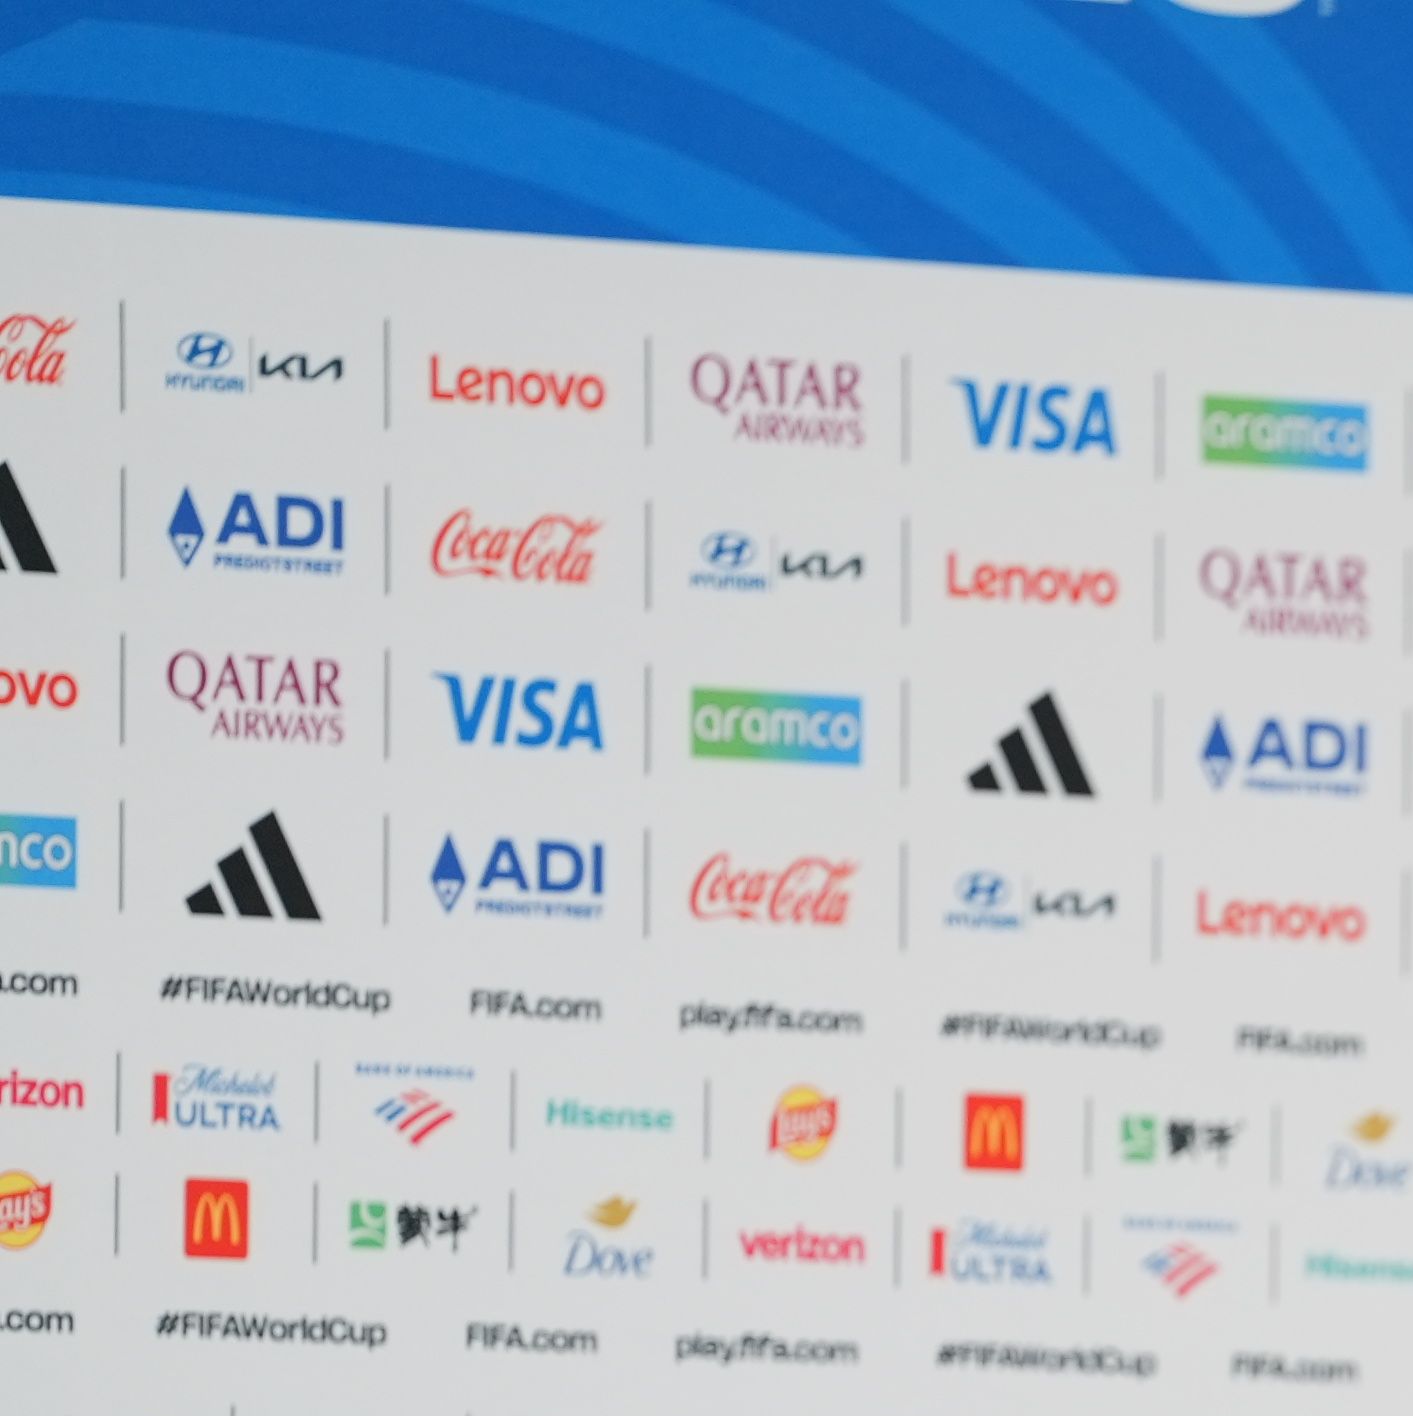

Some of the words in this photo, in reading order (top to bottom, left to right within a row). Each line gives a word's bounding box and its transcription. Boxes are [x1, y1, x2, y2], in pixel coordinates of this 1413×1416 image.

[430, 355, 605, 410] Lenovo
[690, 354, 860, 412] QATAR
[737, 414, 863, 445] AIRWAYS
[959, 380, 1116, 455] VISA
[1206, 410, 1364, 457] aramco
[217, 493, 343, 551] ADI
[431, 510, 598, 583] Coca-Cola
[947, 553, 1118, 606] Lenovo
[1199, 550, 1366, 610] QATAR
[167, 652, 340, 706] QATAR
[212, 700, 343, 743] AIRWAYS
[438, 674, 603, 750] VISA
[695, 703, 856, 750] aramco
[1248, 719, 1366, 772] ADI
[479, 839, 603, 895] ADI
[689, 853, 854, 925] Coca-Cola
[1197, 892, 1366, 942] Lenovo
[161, 976, 390, 1014] #FIFAWorldCup
[470, 990, 601, 1019] FIFA.com
[680, 1003, 862, 1033] play.fifa.com
[941, 1014, 1160, 1049] #FIFAWorldCup
[175, 1102, 279, 1129] ULTRA
[546, 1099, 673, 1130] Hisense
[564, 1235, 653, 1275] Dove
[740, 1228, 865, 1262] verizon
[951, 1256, 1050, 1281] ULTRA
[157, 1312, 387, 1348] #FIFAWorldCup
[466, 1323, 597, 1351] FIFA.com
[676, 1334, 857, 1364] play.fifa.com
